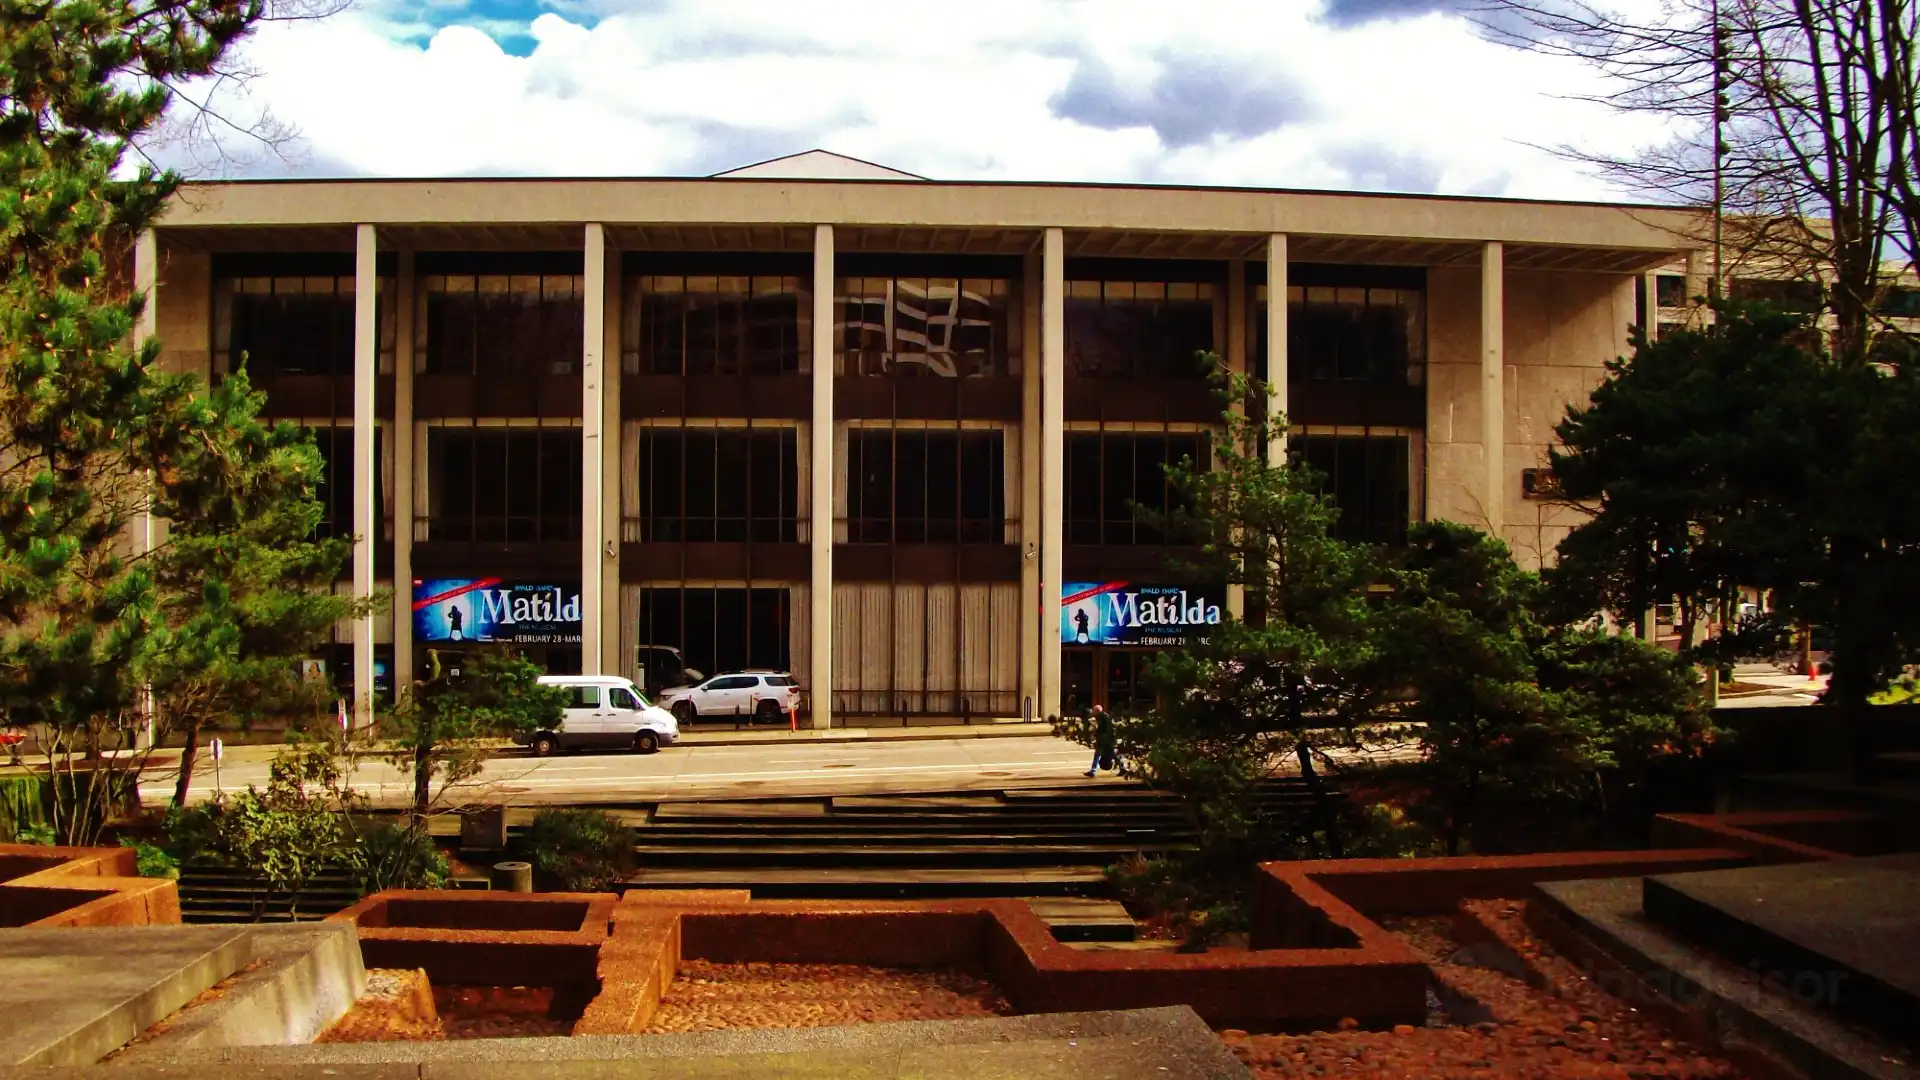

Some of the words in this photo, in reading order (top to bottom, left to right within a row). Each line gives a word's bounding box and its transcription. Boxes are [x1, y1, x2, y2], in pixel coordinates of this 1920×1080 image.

[477, 588, 583, 624] Matild
[1105, 591, 1222, 627] Matilda
[515, 634, 551, 643] FEBRUARY
[552, 634, 582, 643] 28-MAR
[1140, 637, 1177, 646] FEBRUARY
